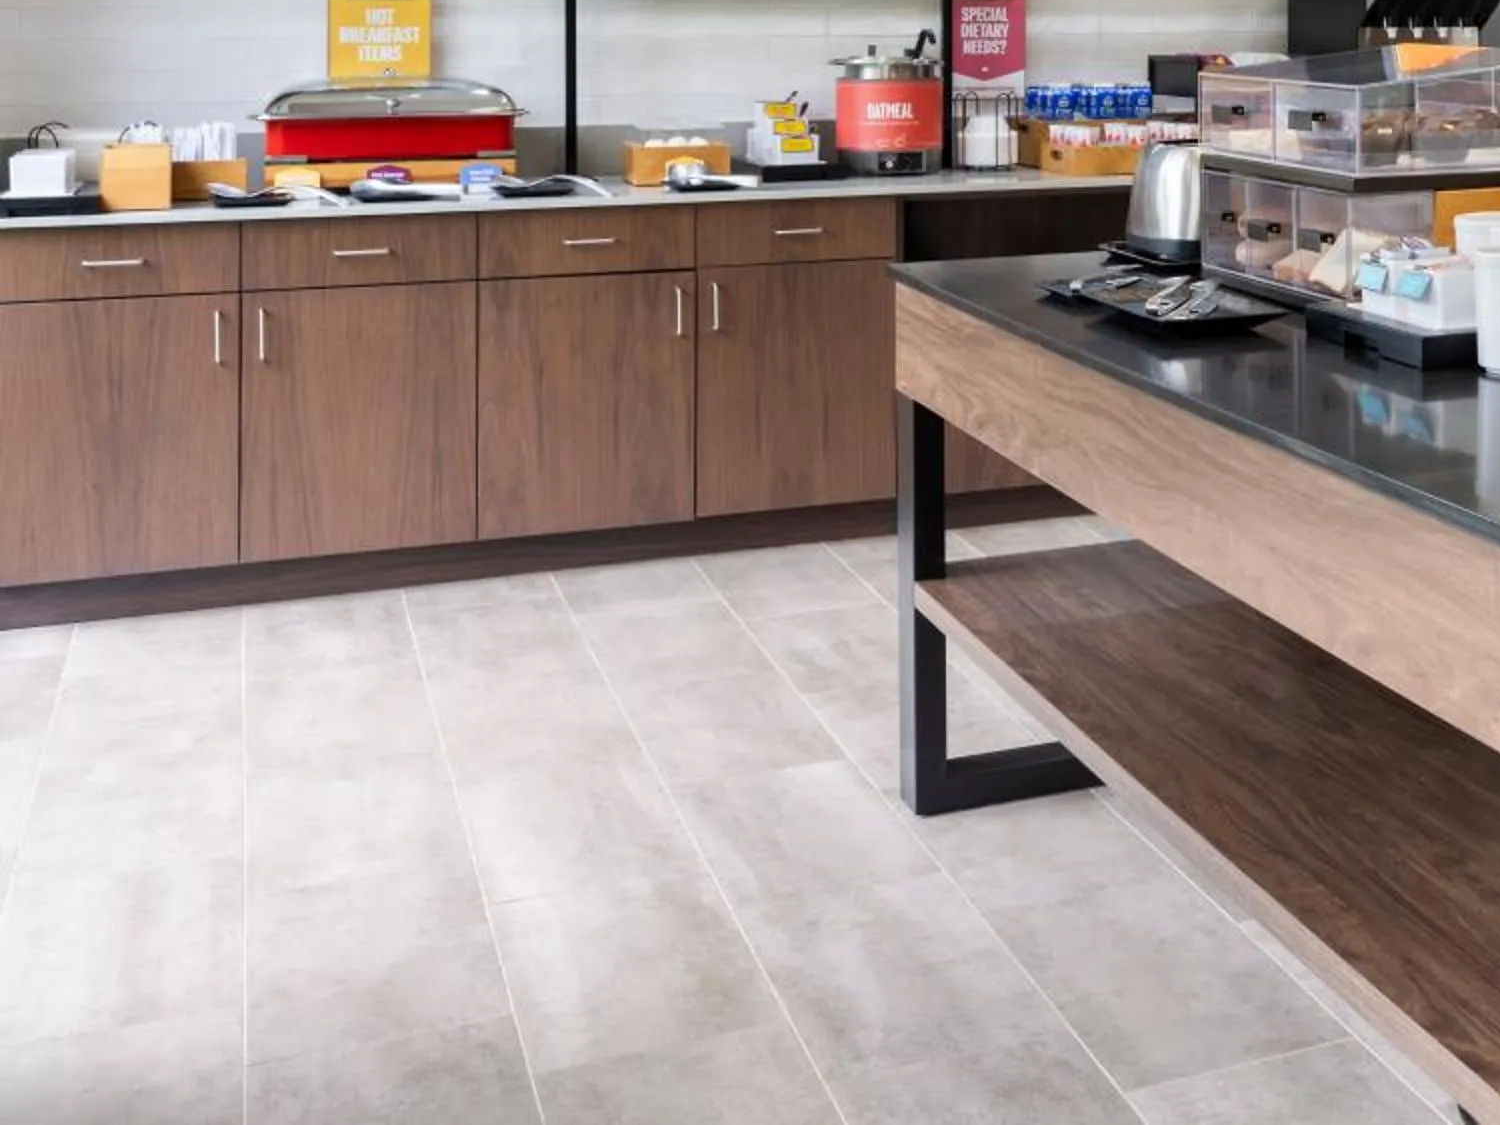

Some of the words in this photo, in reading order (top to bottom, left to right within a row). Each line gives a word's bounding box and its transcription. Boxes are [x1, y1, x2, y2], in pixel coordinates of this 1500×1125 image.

[365, 7, 395, 24] HOT
[961, 6, 1008, 21] SPECIAL
[339, 26, 420, 44] BREAKFAST
[961, 22, 1009, 38] DIETARY
[358, 45, 402, 62] ITEMS
[963, 39, 1007, 55] NEEDS?
[867, 102, 914, 120] OATMEAL
